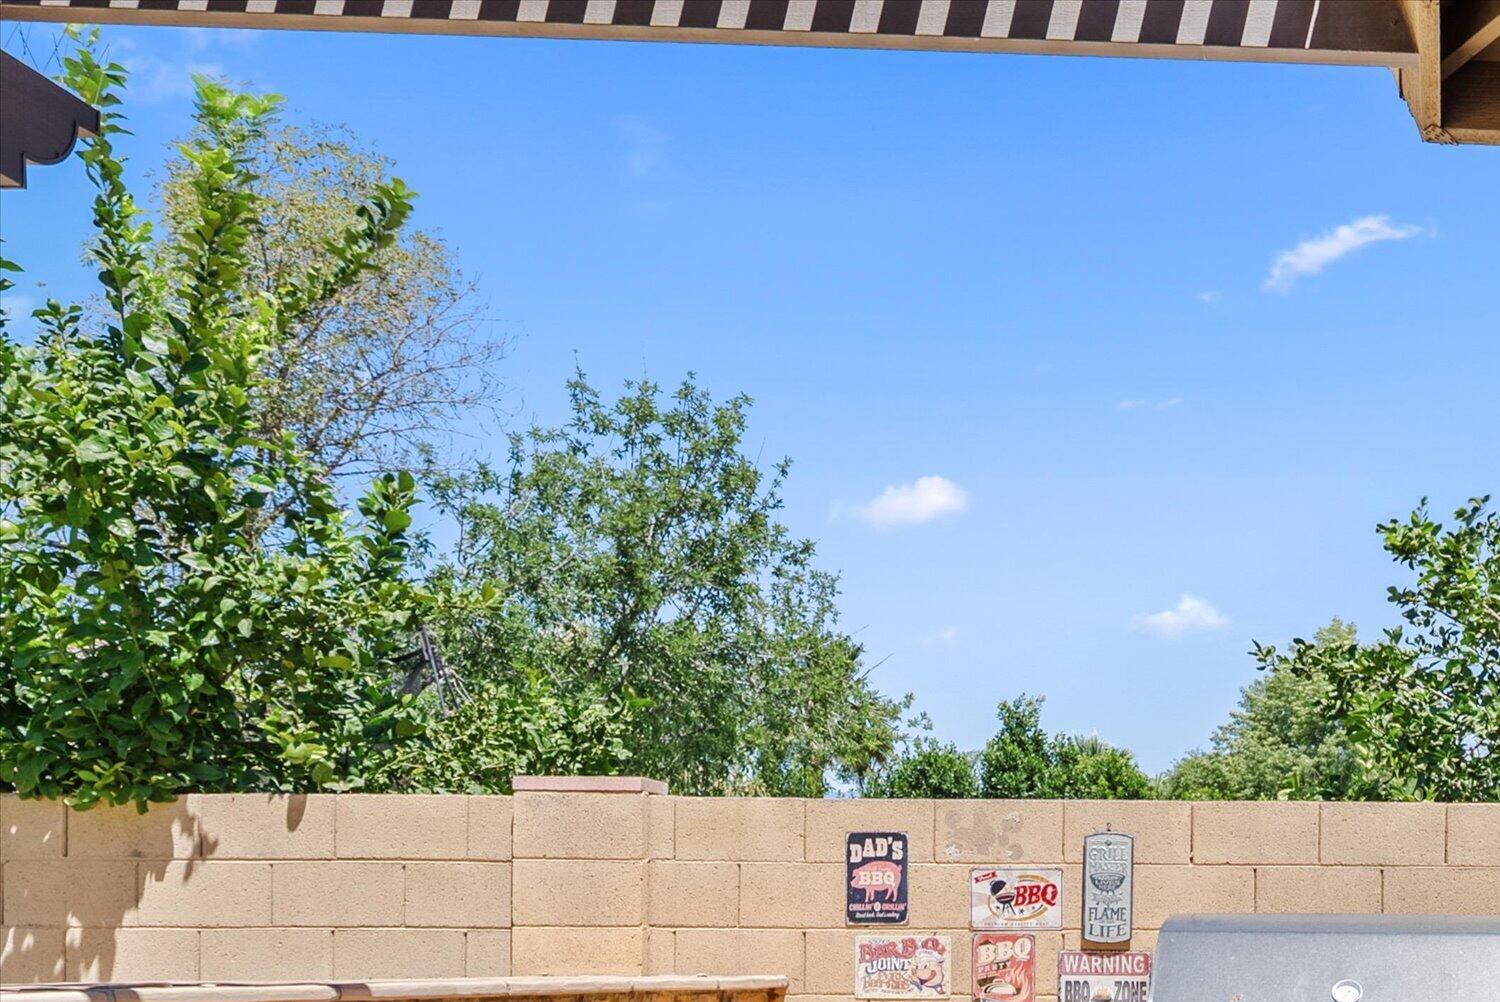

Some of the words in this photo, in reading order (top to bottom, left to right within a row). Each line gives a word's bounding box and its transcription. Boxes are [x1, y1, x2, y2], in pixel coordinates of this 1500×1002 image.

[849, 836, 904, 863] DAD'S
[1089, 847, 1128, 861] GRILL
[859, 871, 896, 888] BBQ
[1013, 883, 1058, 907] BBQ
[1089, 906, 1127, 922] FLAME
[1089, 923, 1127, 938] LIFE
[976, 937, 1032, 965] BBQ
[865, 957, 912, 975] JOINT
[977, 961, 1012, 973] PARTY
[1063, 954, 1146, 974] WARNING
